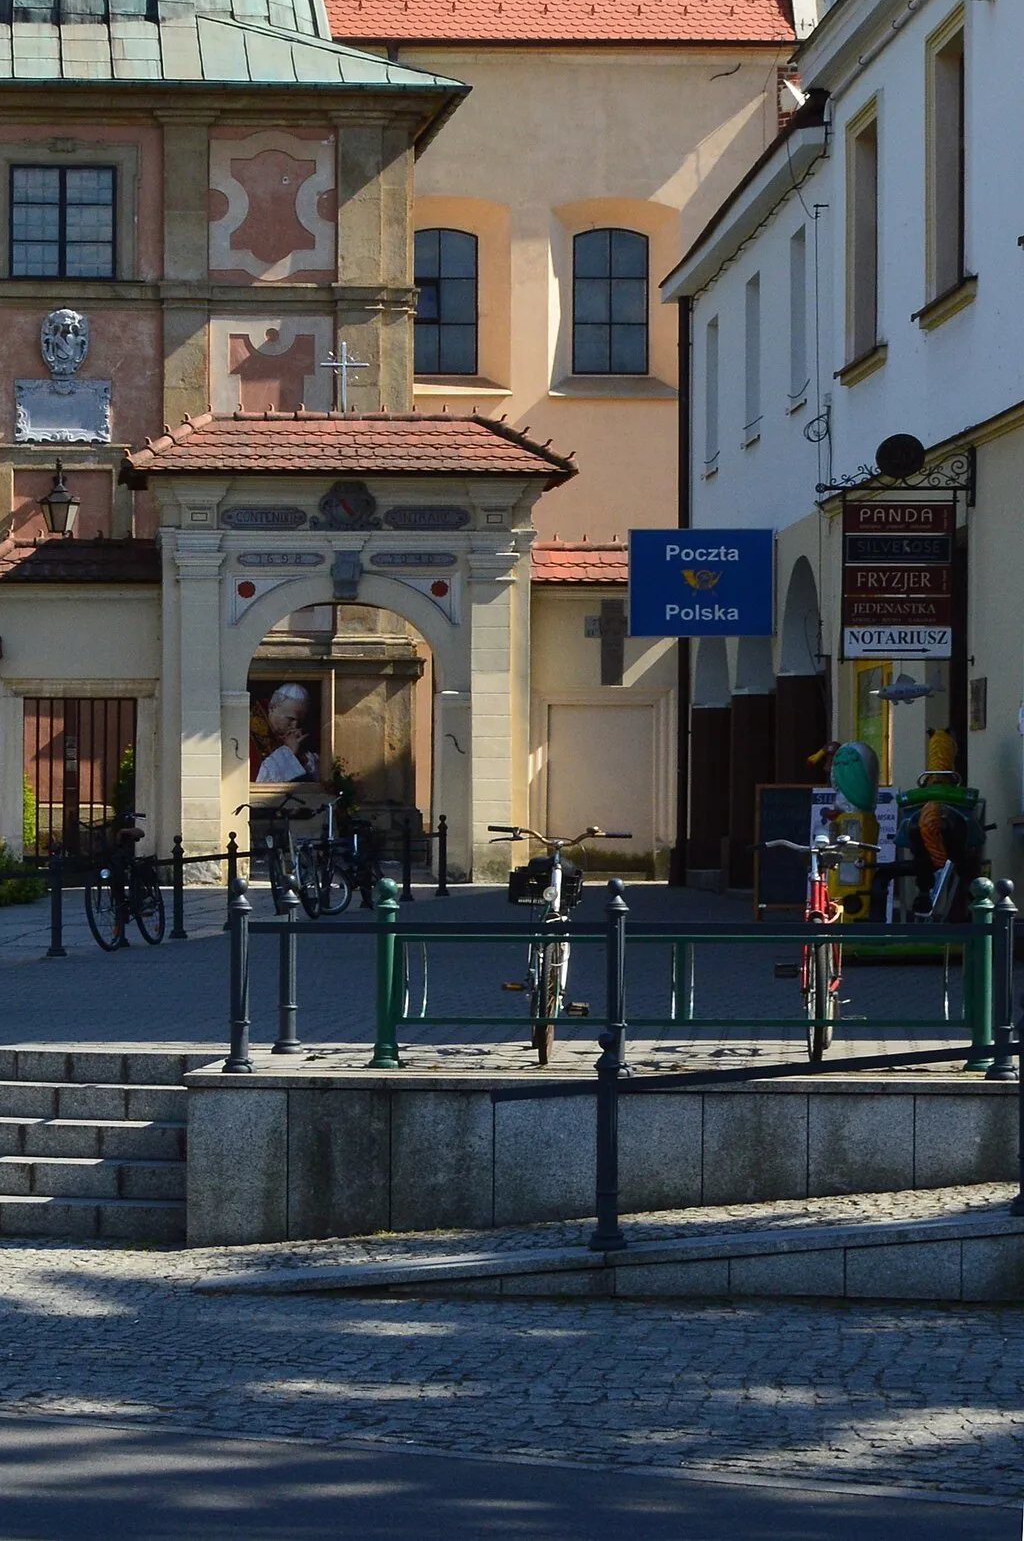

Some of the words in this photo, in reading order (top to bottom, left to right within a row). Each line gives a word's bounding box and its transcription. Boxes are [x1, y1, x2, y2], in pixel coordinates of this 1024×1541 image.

[859, 508, 933, 522] PANDA
[665, 544, 740, 561] Poczta
[857, 572, 931, 591] FRYZJER
[665, 604, 740, 621] Polska
[852, 602, 936, 616] JEDENASTKA
[848, 630, 948, 645] NOTARIUSZ
